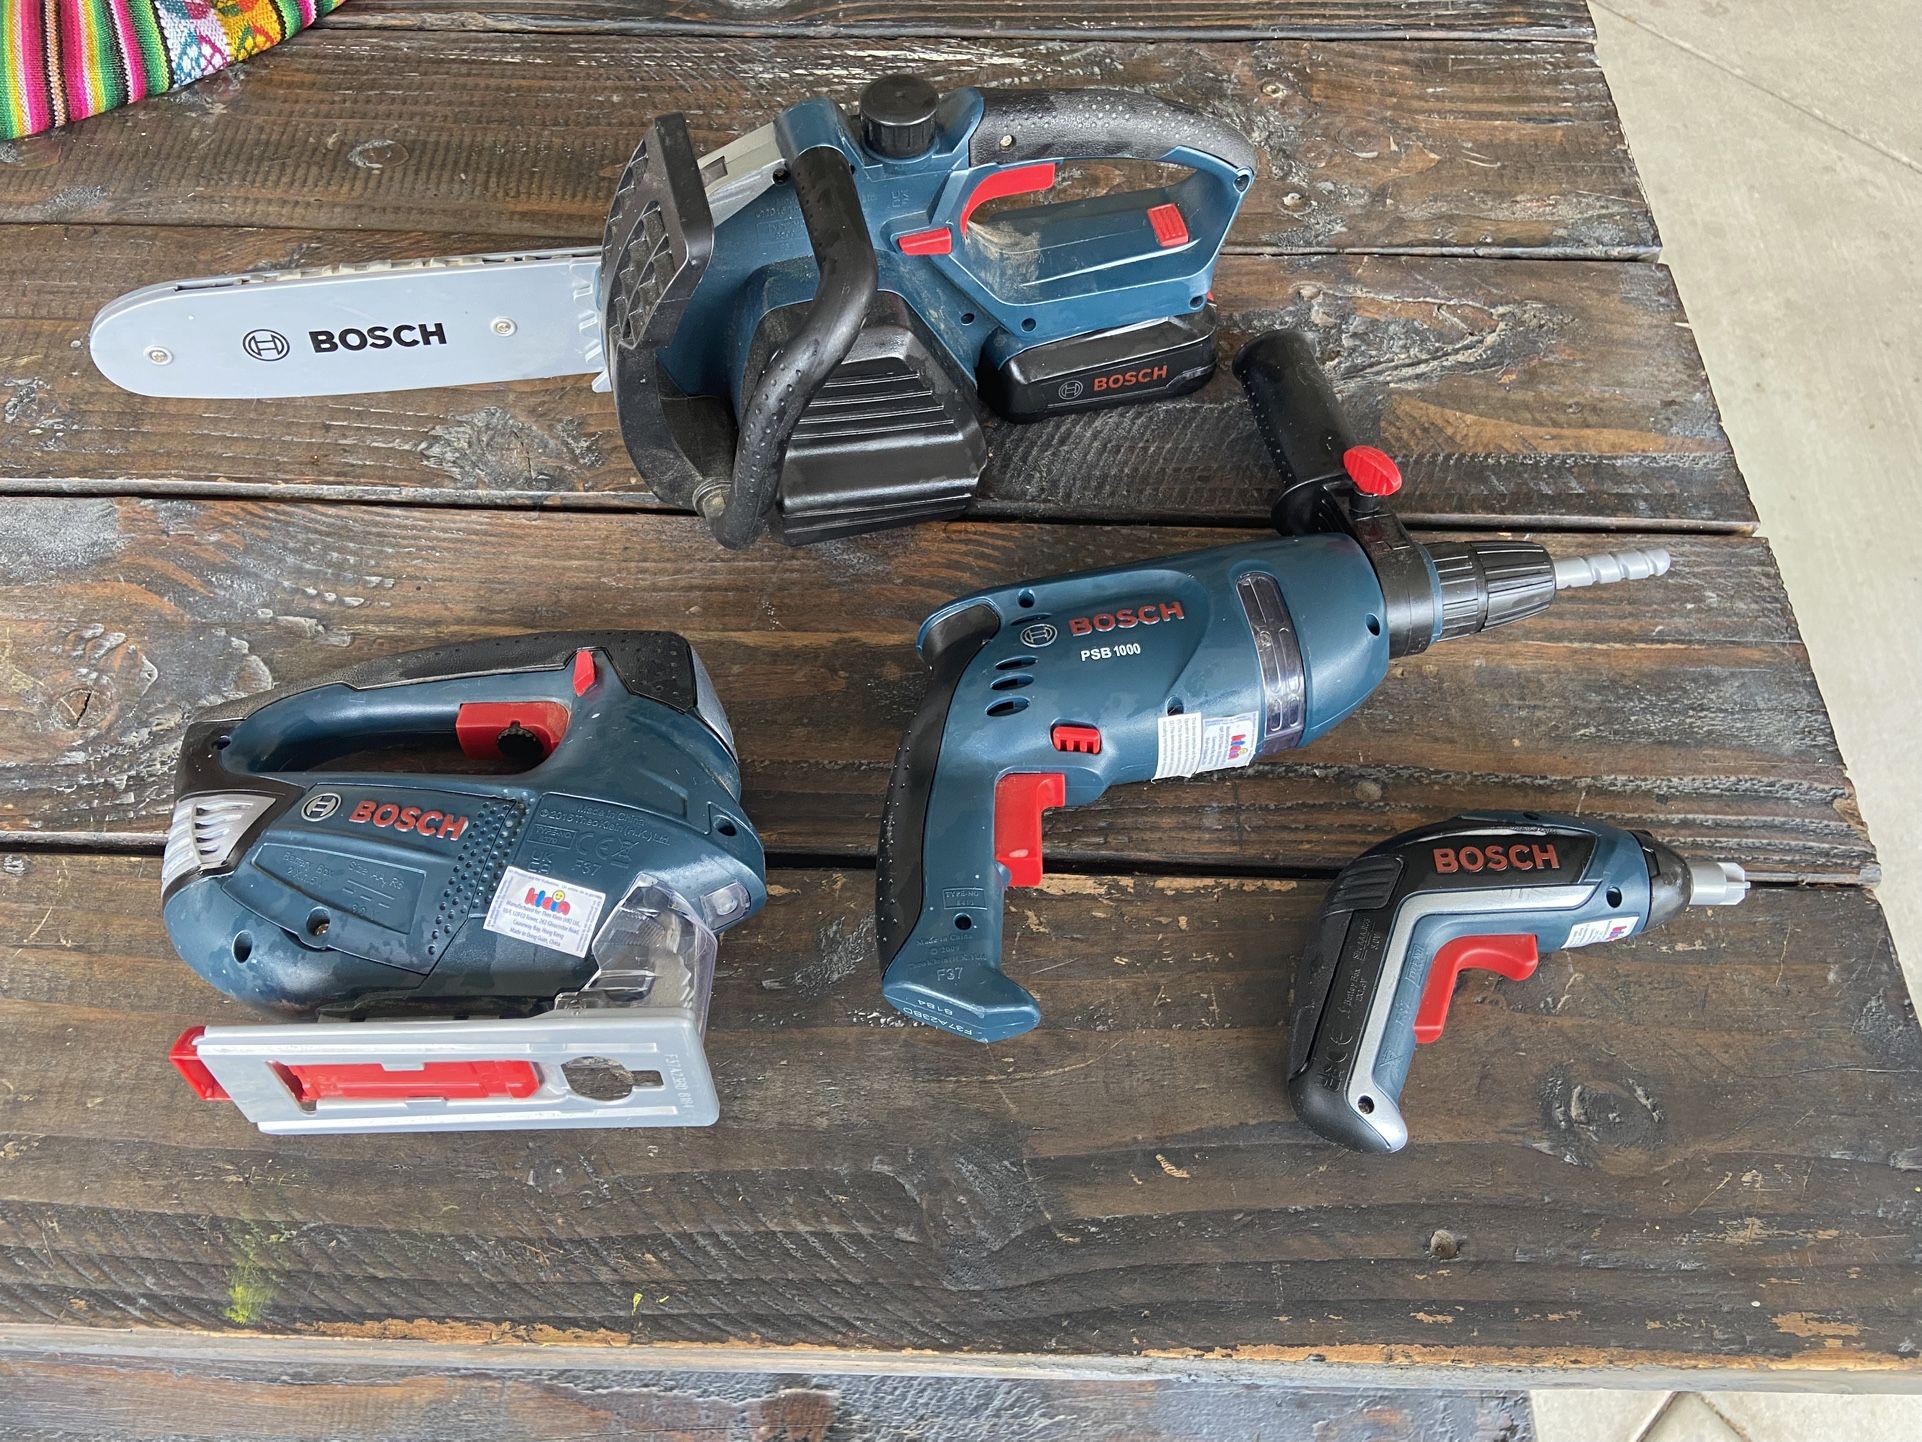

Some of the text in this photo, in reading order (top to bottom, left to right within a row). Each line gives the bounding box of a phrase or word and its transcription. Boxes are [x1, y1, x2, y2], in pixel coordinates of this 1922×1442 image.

[308, 322, 447, 353] BOSCH
[1093, 365, 1168, 391] BOSCH
[1068, 601, 1184, 637] BOSCH
[1080, 643, 1141, 661] PSB 1000
[349, 800, 469, 841] BOSCH
[1433, 845, 1559, 873] BOSCH
[524, 887, 571, 916] klein
[936, 967, 963, 981] F37
